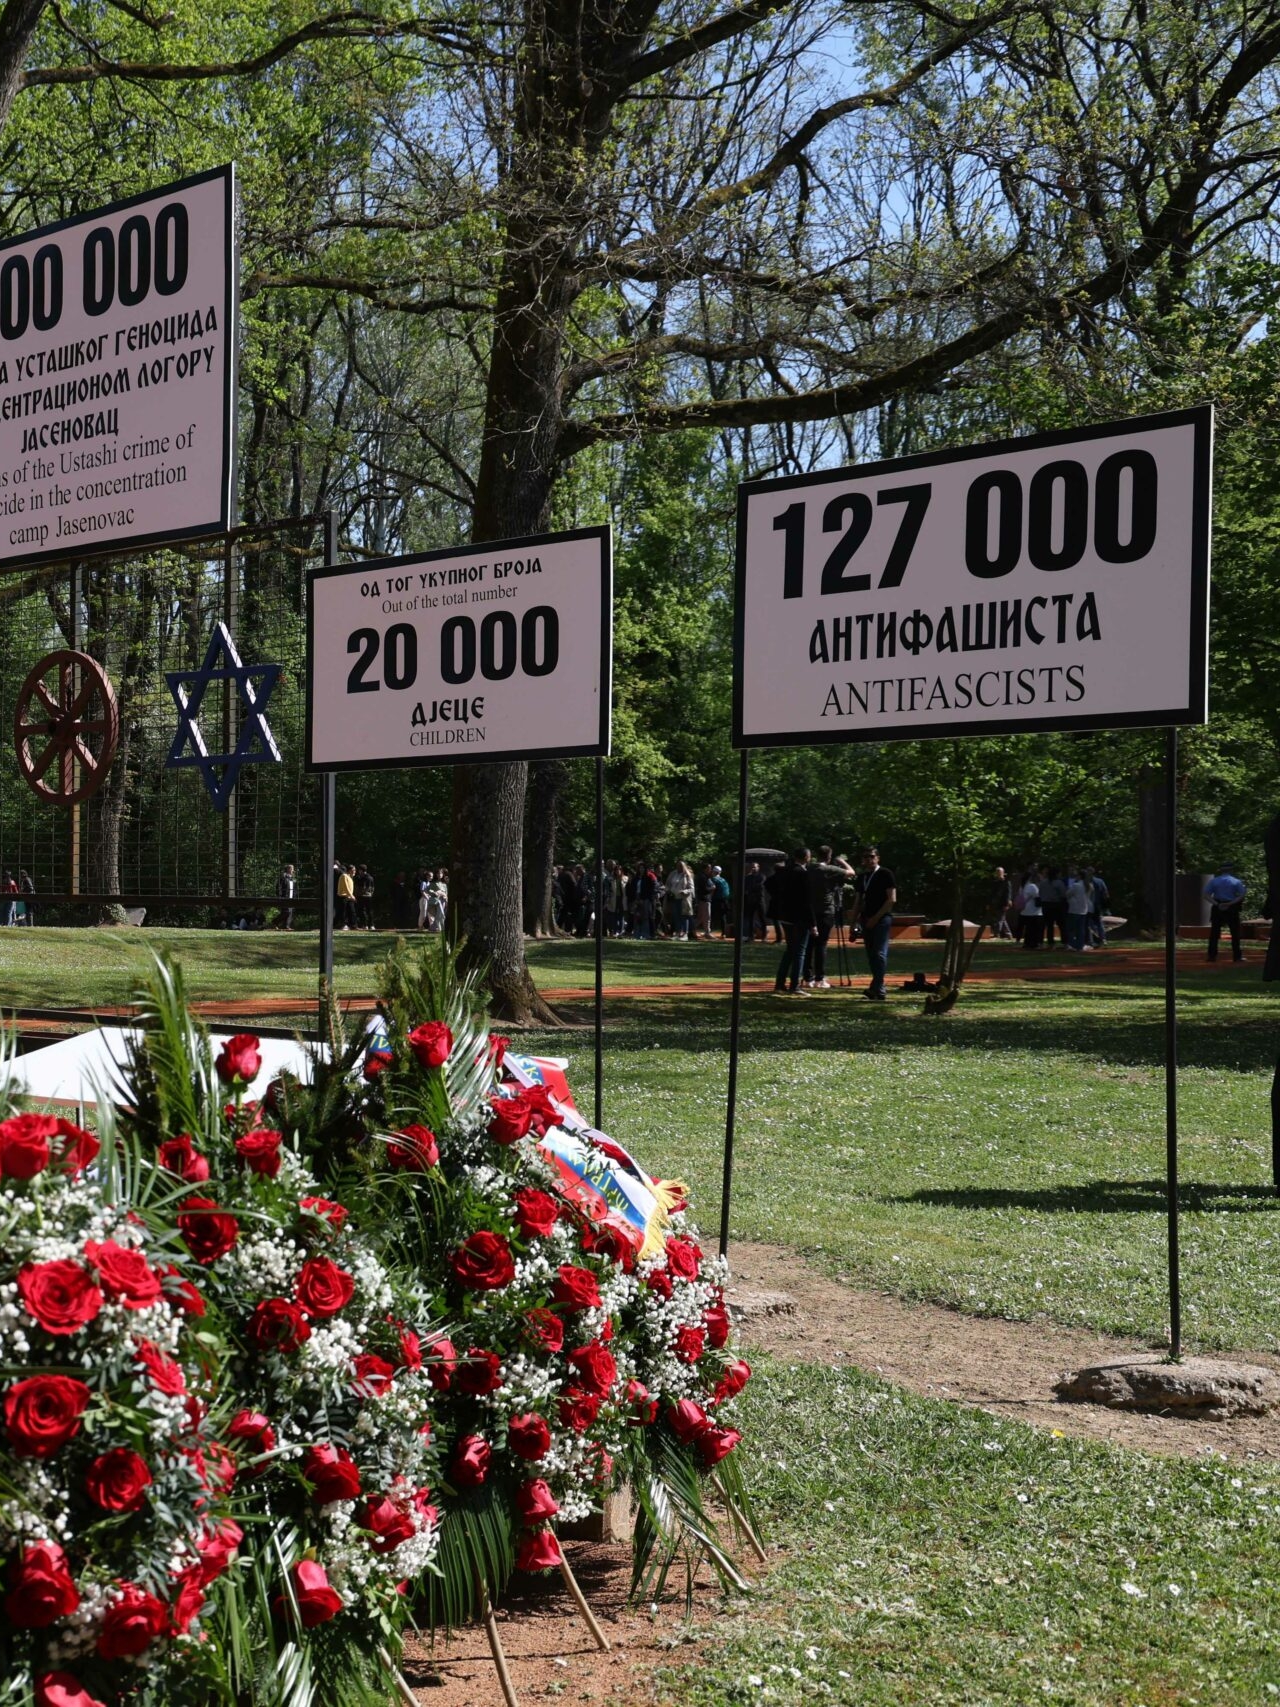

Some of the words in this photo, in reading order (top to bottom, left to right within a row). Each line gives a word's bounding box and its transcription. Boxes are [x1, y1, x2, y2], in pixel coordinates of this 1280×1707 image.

[83, 202, 188, 317] 000
[15, 334, 108, 382] УСТАШКОГ
[115, 305, 218, 356] ГЕНОЦИДА
[138, 345, 216, 389] ЛОГОРУ
[14, 460, 31, 483] of
[32, 456, 55, 479] the
[59, 441, 118, 477] Ustashi
[122, 433, 170, 461] crime
[175, 424, 196, 448] of
[20, 408, 119, 454] ЈАСЕНОВАЦ
[30, 487, 44, 509] in
[49, 483, 71, 506] the
[76, 464, 187, 501] concentration
[9, 523, 49, 546] camp
[56, 505, 135, 538] Jasenovac
[773, 483, 932, 599] 127
[964, 449, 1158, 579] 000
[360, 581, 381, 597] ОД
[386, 575, 413, 594] ТОГ
[420, 564, 489, 589] УКУПНОГ
[493, 557, 542, 579] БРОЈА
[382, 598, 403, 614] Out
[406, 596, 420, 611] of
[421, 594, 438, 608] the
[442, 590, 467, 606] total
[472, 585, 518, 602] number
[347, 623, 417, 694] 20
[440, 605, 559, 685] 000
[808, 591, 1102, 664] АНТИФАШИСТА
[411, 696, 485, 727] ДЈЕЦЕ
[820, 665, 1086, 717] ANTIFASCISTS
[410, 726, 487, 746] CHILDREN
